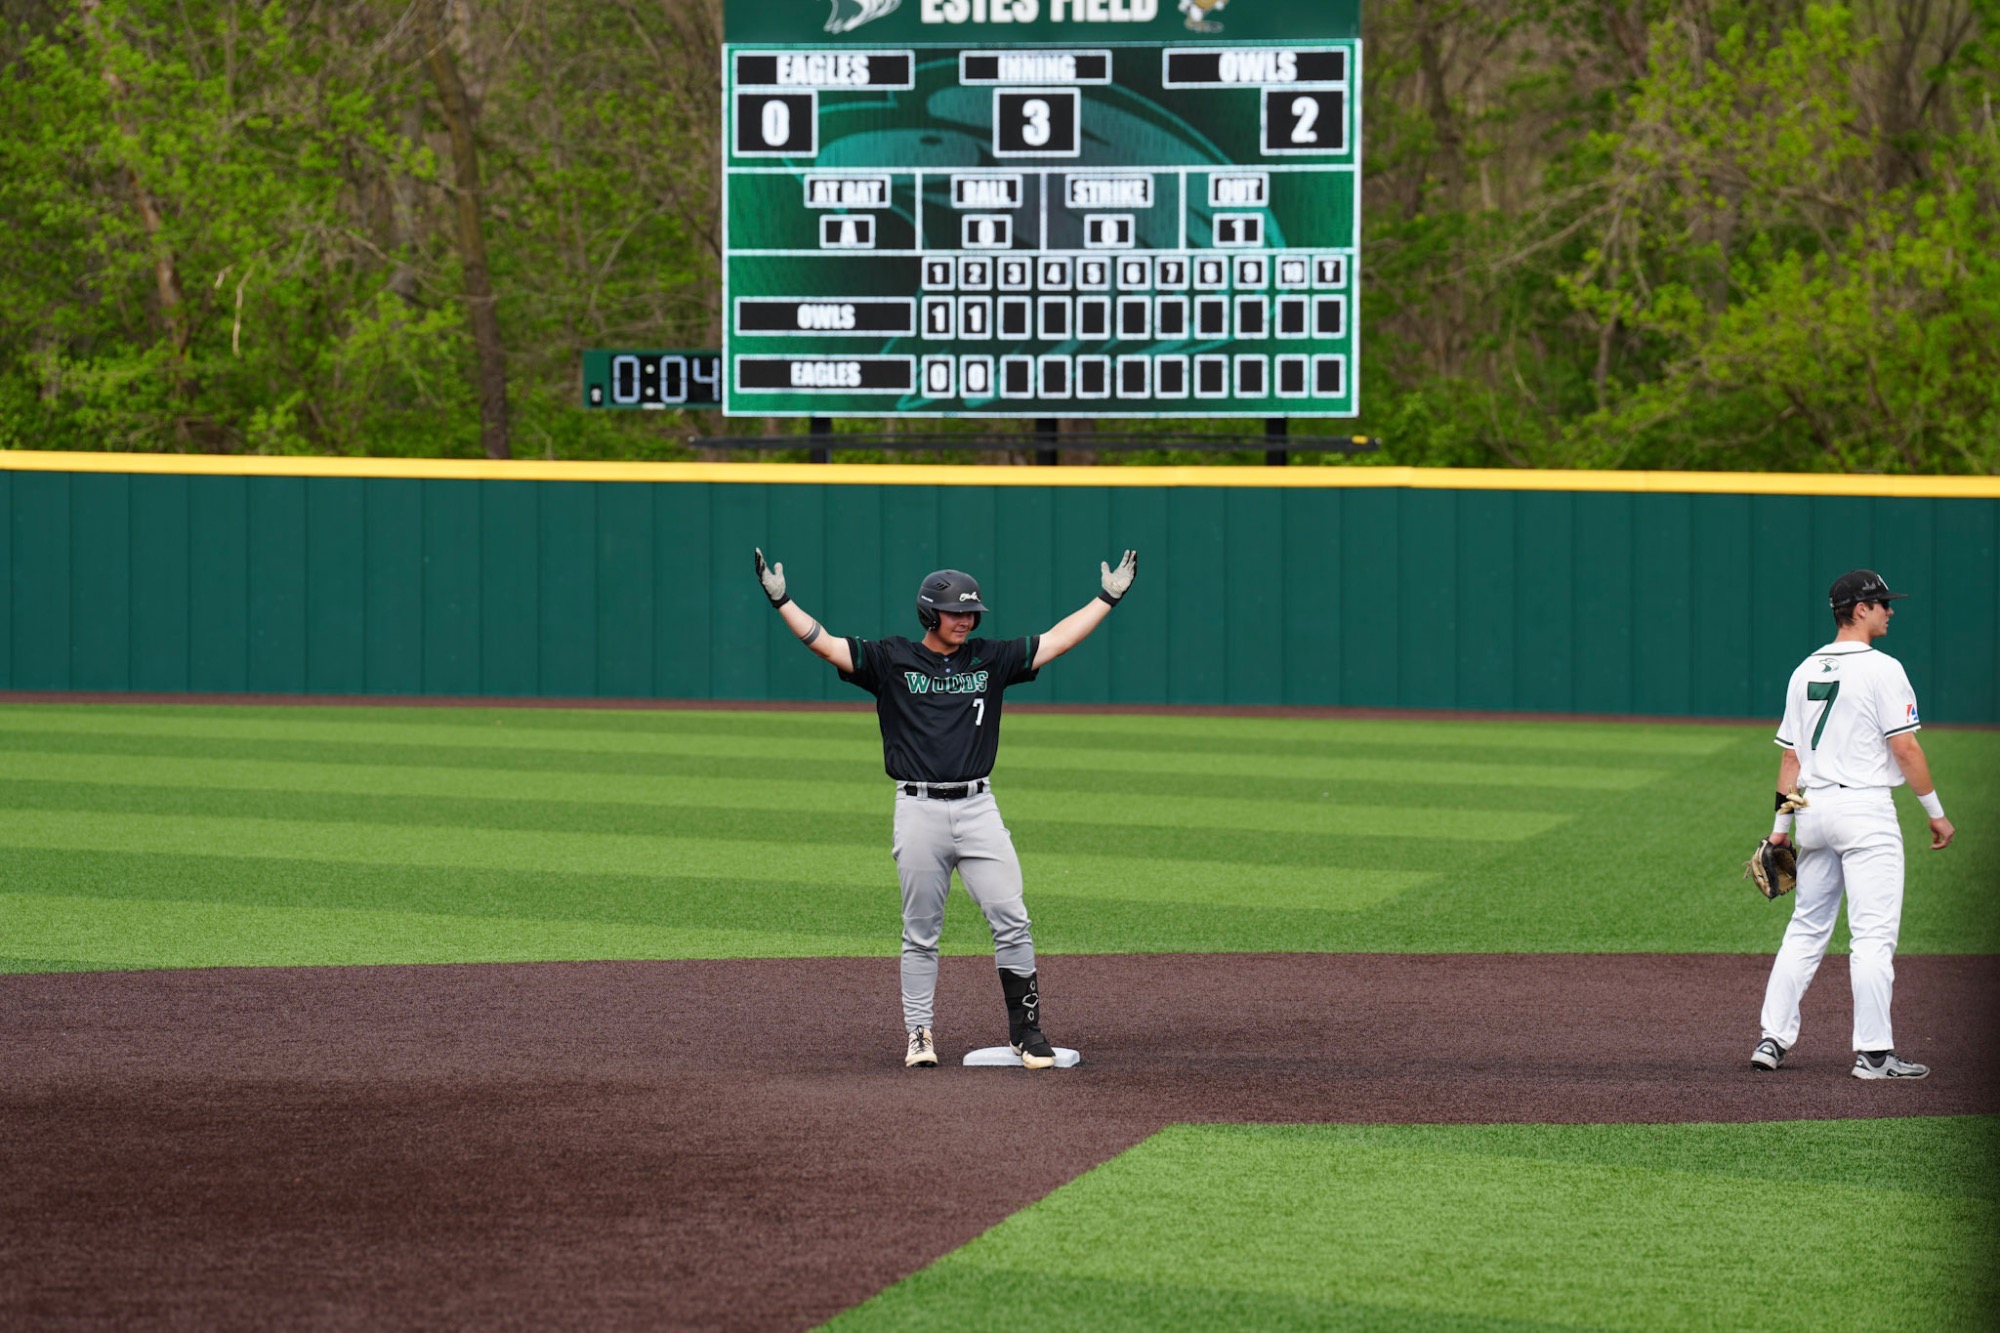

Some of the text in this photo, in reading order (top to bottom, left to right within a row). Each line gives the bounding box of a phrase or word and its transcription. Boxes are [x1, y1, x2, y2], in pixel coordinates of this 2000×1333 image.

[776, 55, 870, 84] EAGLES
[1218, 50, 1297, 82] OWLS
[761, 99, 790, 147] 0
[1022, 98, 1051, 147] 3
[1290, 96, 1319, 143] 2
[1072, 179, 1145, 202] STRIKE
[1231, 218, 1245, 244] 1
[932, 265, 944, 283] 1
[968, 264, 982, 284] 2
[1008, 264, 1021, 283] 3
[1047, 263, 1061, 283] 4
[1087, 263, 1100, 283] 5
[1126, 263, 1140, 283] 6
[1166, 263, 1178, 283] 7
[1204, 262, 1217, 283] 8
[1243, 262, 1258, 283] 9
[797, 304, 855, 330] OWLS
[931, 305, 982, 332] 1 1
[613, 355, 720, 404] 0:04
[790, 361, 862, 387] EAGLES
[930, 363, 986, 390] 0 0
[972, 698, 985, 726] 7
[1807, 680, 1840, 750] 7
